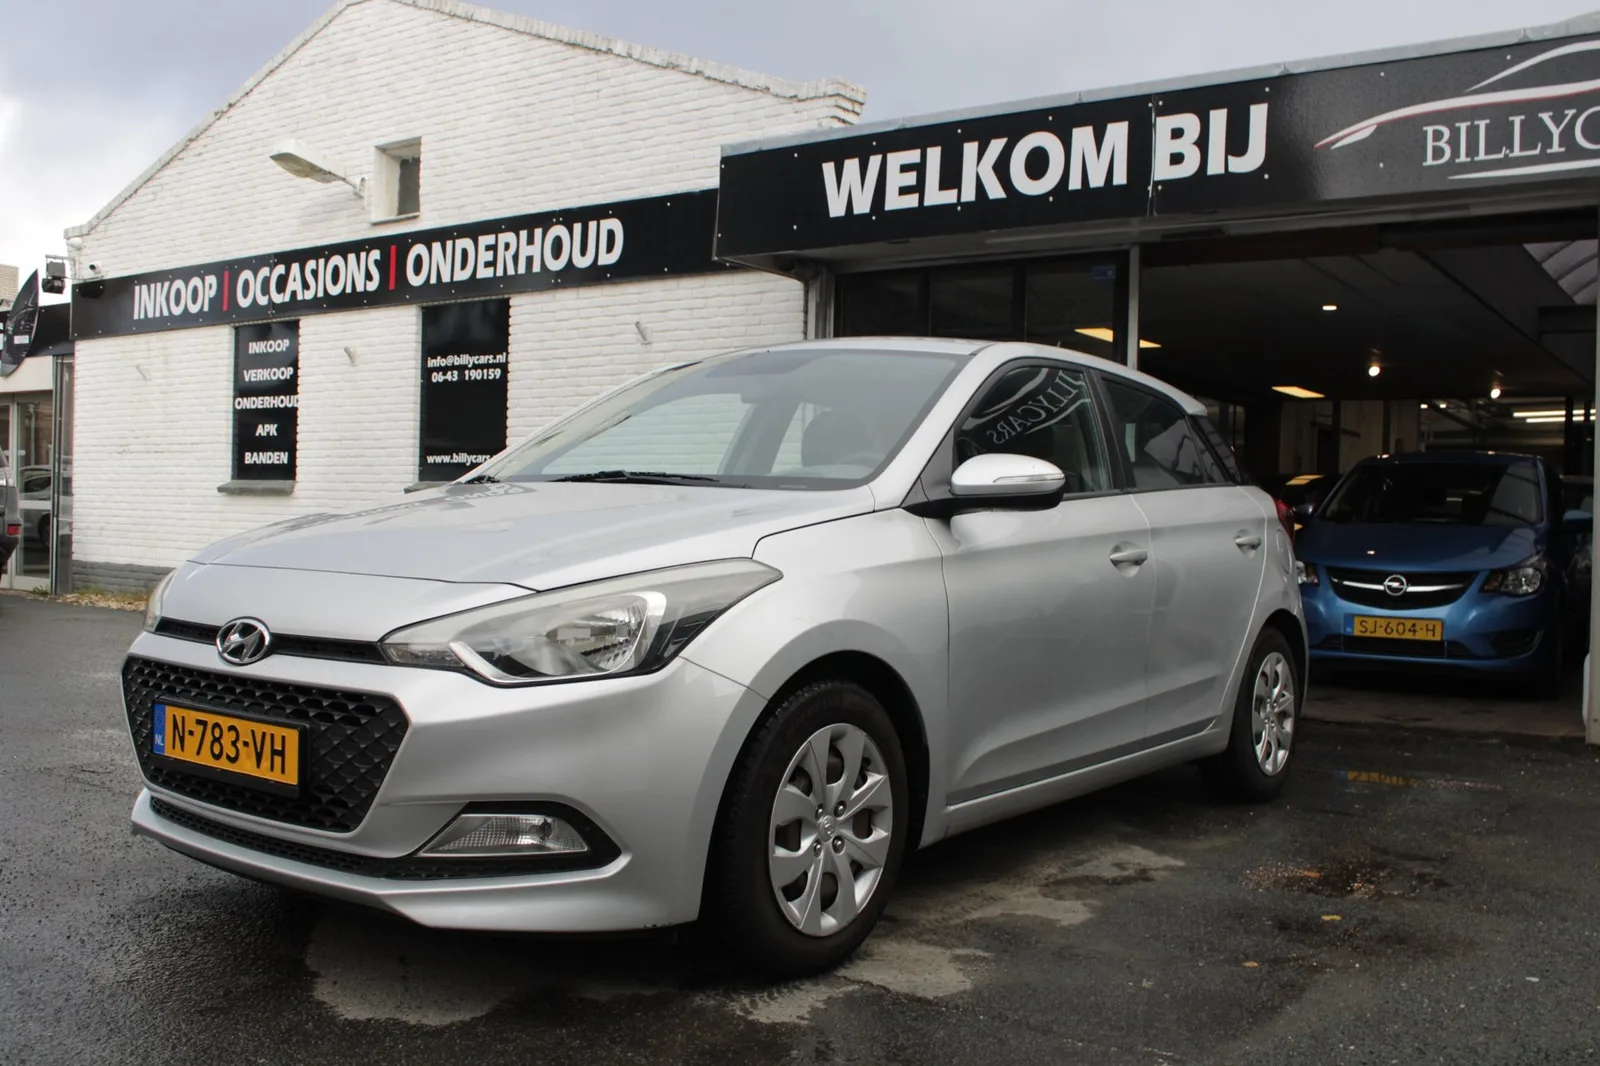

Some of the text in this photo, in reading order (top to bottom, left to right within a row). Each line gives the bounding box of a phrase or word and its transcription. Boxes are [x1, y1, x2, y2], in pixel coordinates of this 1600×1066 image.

[822, 102, 1269, 218] WELKOM BIJ
[133, 217, 624, 320] INKOOP OCCASIONS ONDERHOUD
[248, 339, 290, 354] INKOOP
[427, 352, 506, 368] info@billycars.nl
[243, 367, 294, 382] VERKOOP
[431, 368, 502, 383] 06-43 190159
[255, 424, 278, 437] APK
[244, 452, 288, 464] BANDEN
[1359, 619, 1437, 638] SJ-604-H
[172, 713, 286, 775] N-783-VH
